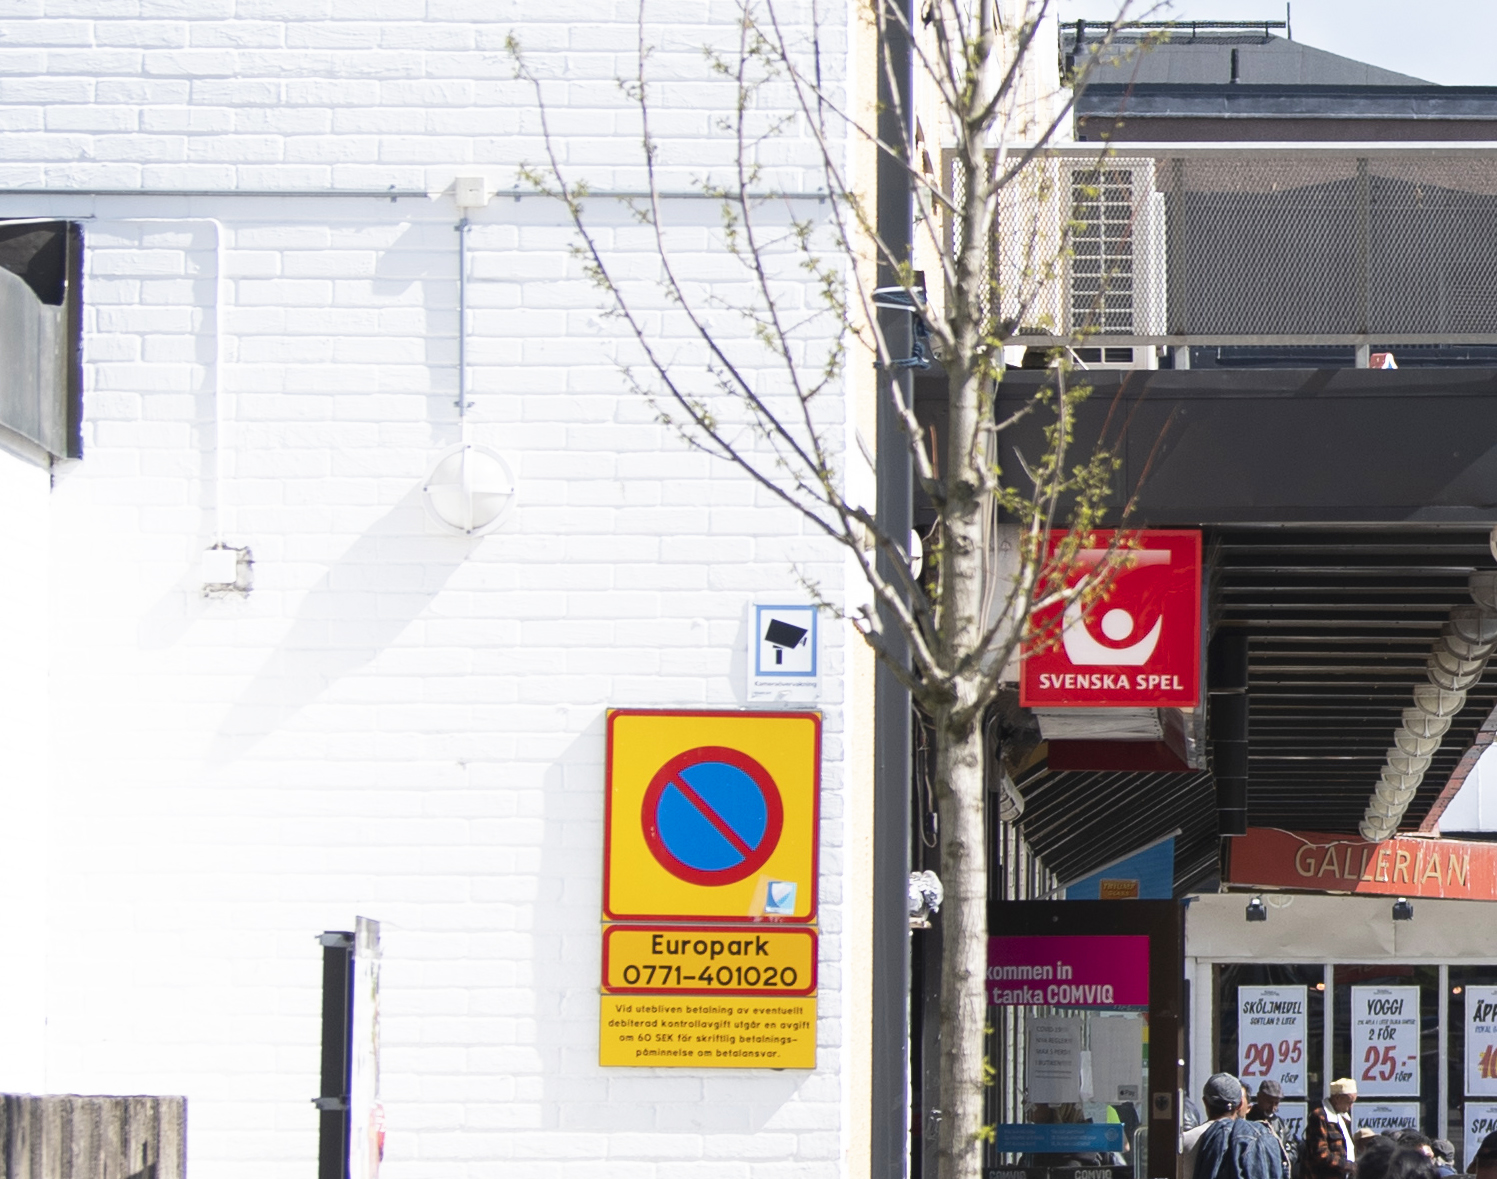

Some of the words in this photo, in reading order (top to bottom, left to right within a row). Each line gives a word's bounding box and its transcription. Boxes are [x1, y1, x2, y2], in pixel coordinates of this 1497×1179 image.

[1038, 672, 1130, 690] SVENSKA
[1135, 674, 1184, 692] SPEL
[1295, 846, 1468, 886] GALLERIAN
[652, 934, 769, 960] Europark
[623, 965, 798, 987] 0771-401020
[985, 965, 1052, 980] kommen
[1057, 961, 1073, 980] in
[993, 985, 1044, 1004] tanka
[1047, 984, 1115, 1004] COMVIQ
[615, 1004, 633, 1013] Vid
[636, 1005, 682, 1014] utebliven
[686, 1005, 733, 1016] betalning
[1243, 998, 1303, 1015] SKÖLJMEDEL
[1367, 999, 1404, 1016] YOGGI
[608, 1019, 658, 1028] debiterad
[734, 1020, 760, 1031] utgår
[780, 1021, 810, 1031] avgift
[1250, 1017, 1275, 1026] SOFTLAN
[638, 1034, 652, 1042] 60
[655, 1034, 674, 1043] SEK
[677, 1033, 692, 1042] för
[696, 1034, 736, 1045] skriftlig
[1368, 1029, 1375, 1041] 2
[1377, 1026, 1396, 1041] FÖR
[1242, 1043, 1275, 1077] 29
[1278, 1040, 1302, 1063] 95
[1281, 1073, 1299, 1084] FÖRP
[1395, 1072, 1412, 1082] FÖRP
